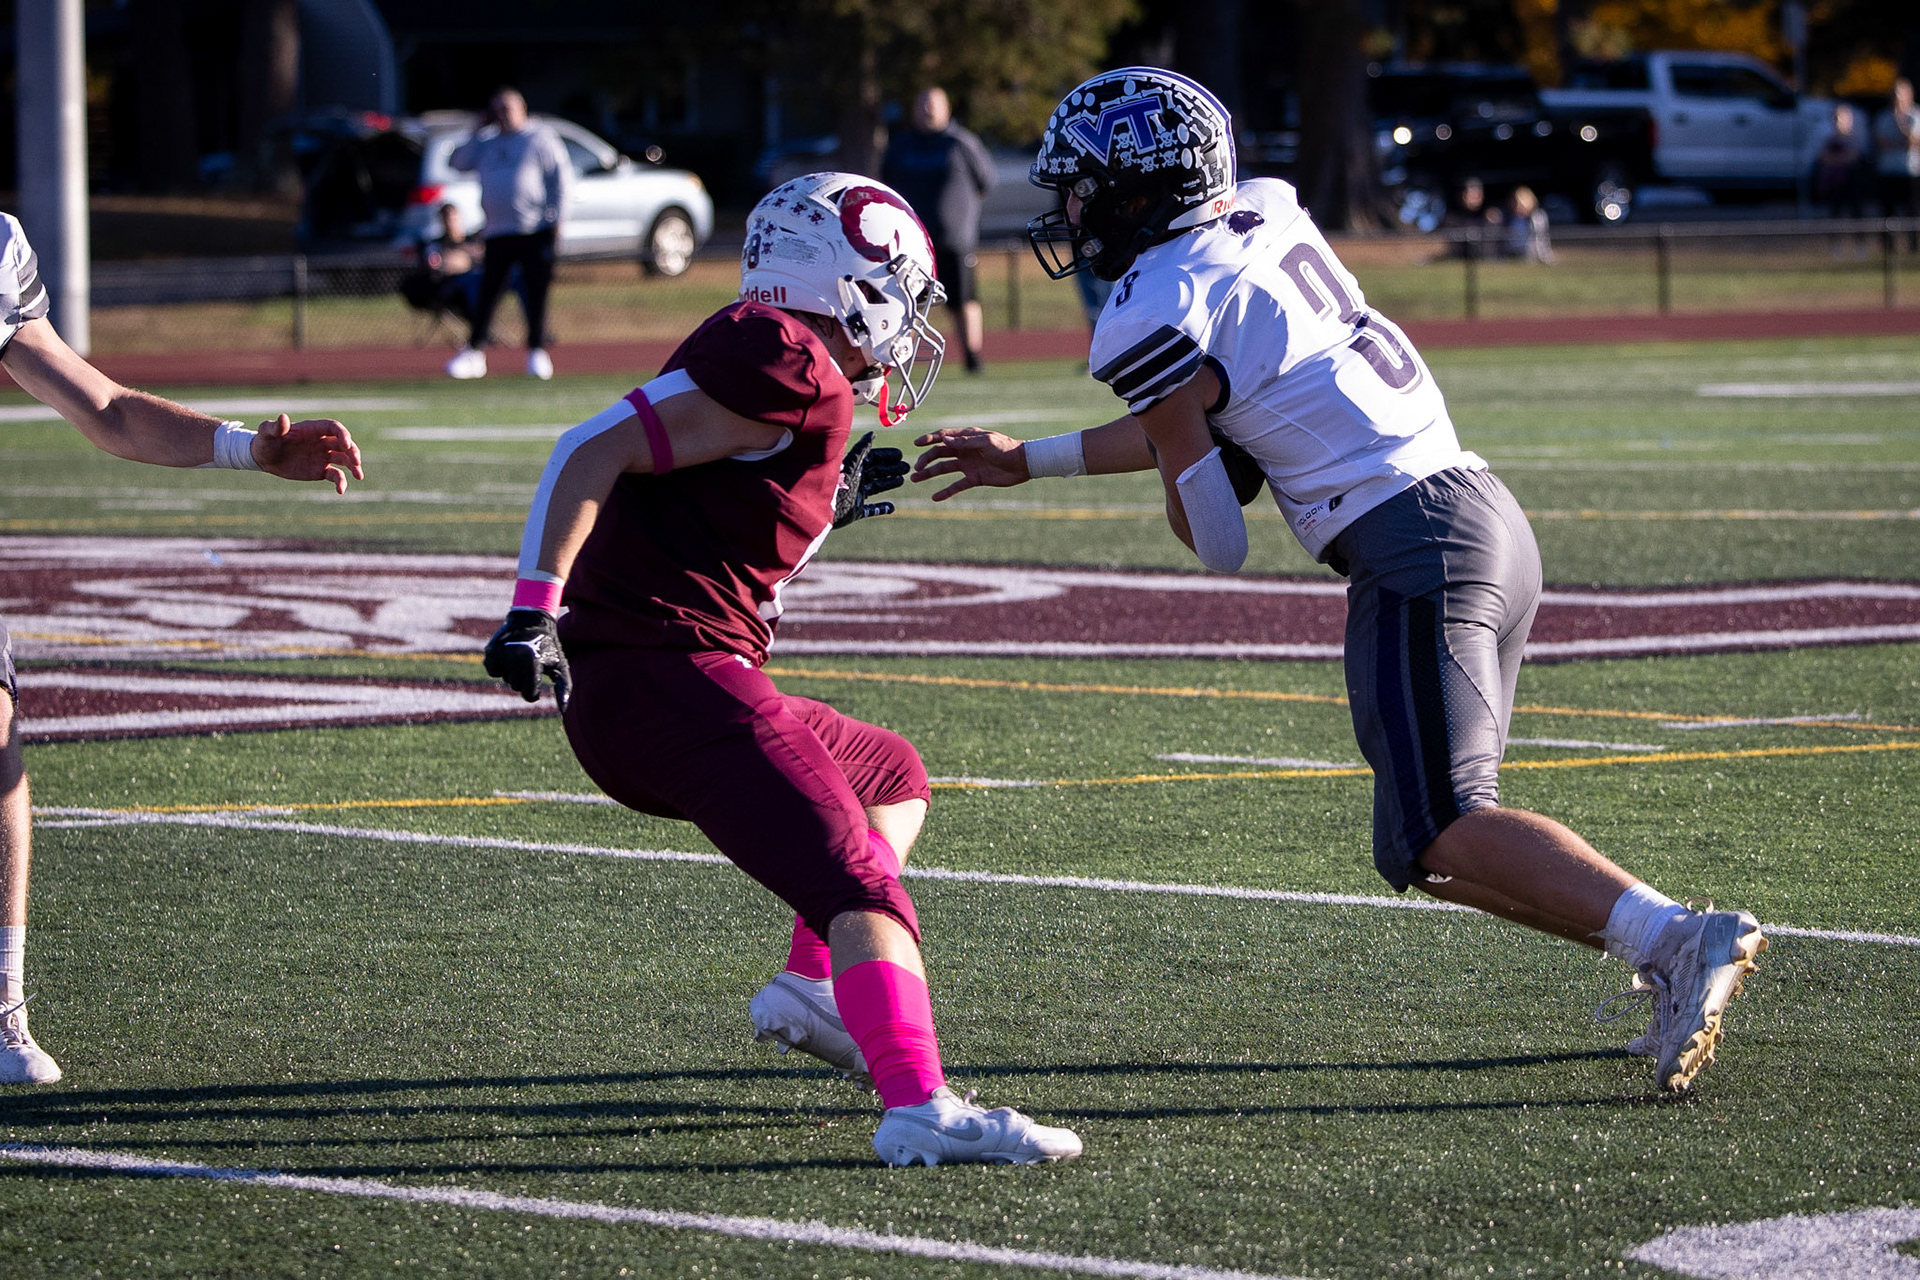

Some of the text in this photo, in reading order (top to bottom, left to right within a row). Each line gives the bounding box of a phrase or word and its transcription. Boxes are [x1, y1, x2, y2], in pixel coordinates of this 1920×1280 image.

[1068, 96, 1164, 167] VT
[1115, 270, 1140, 309] 3
[1279, 243, 1423, 394] 3
